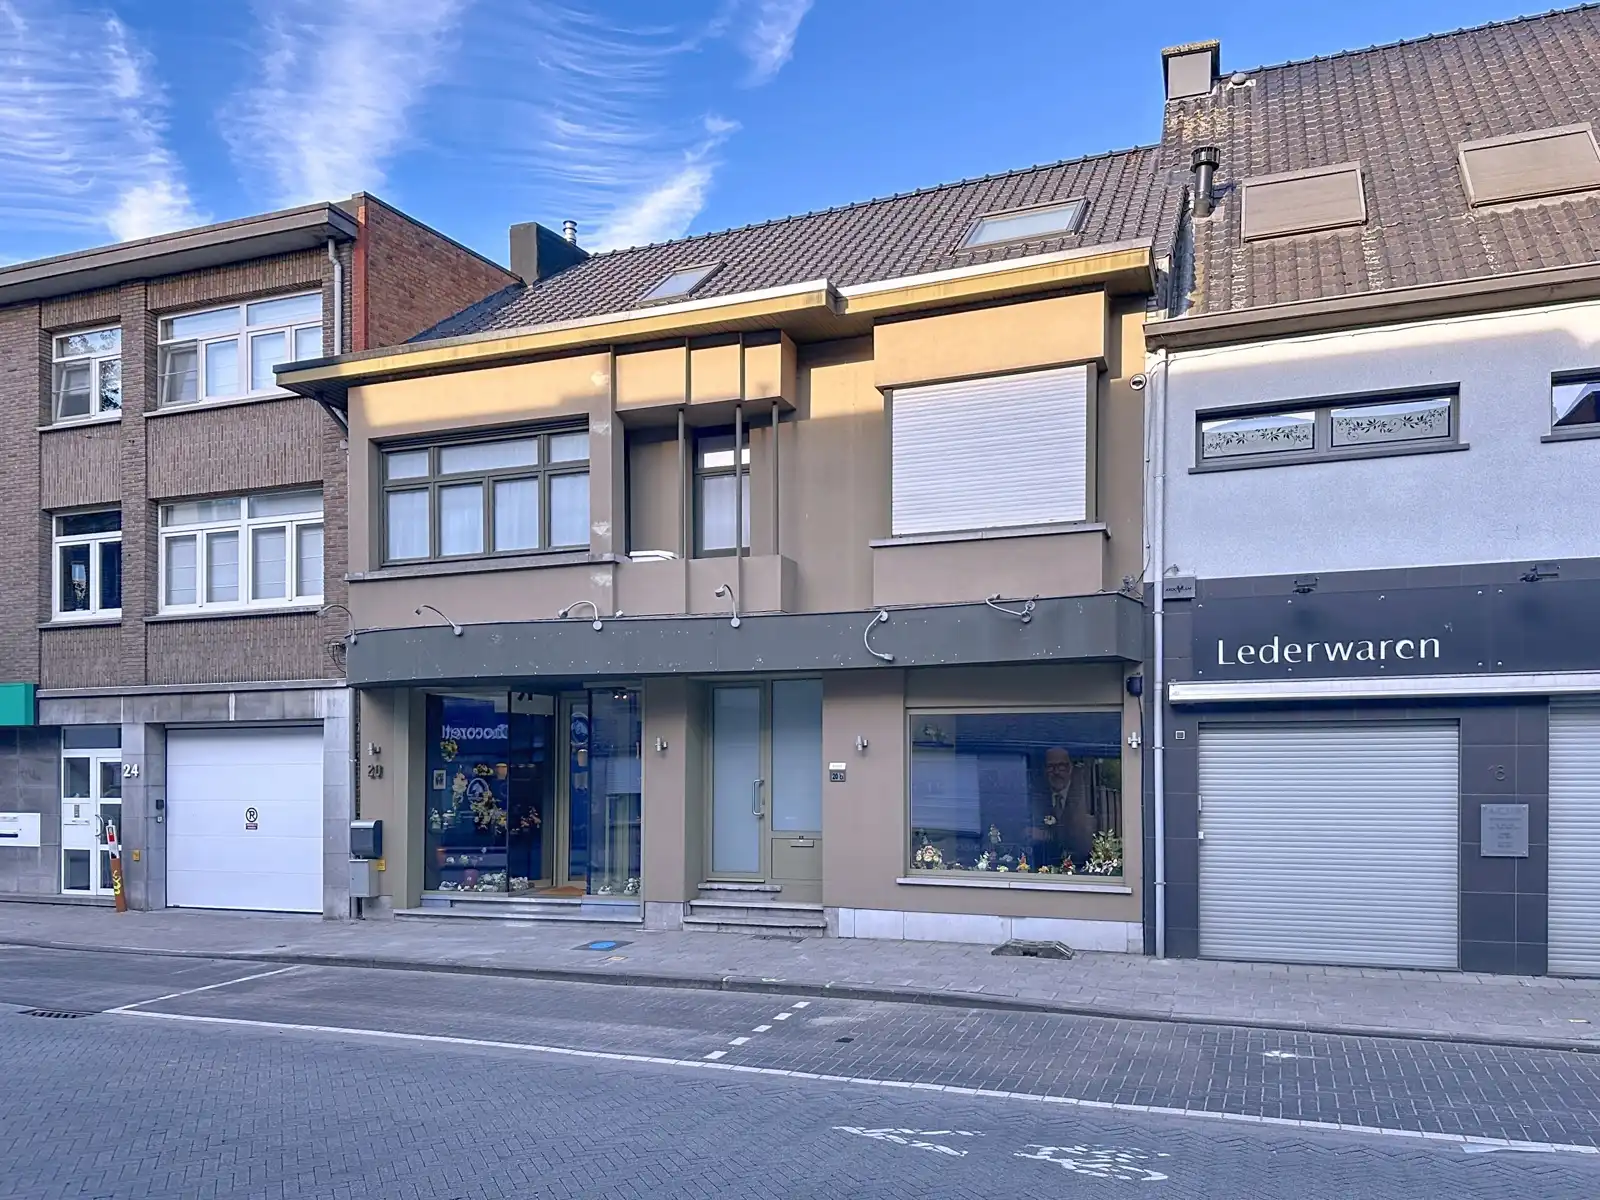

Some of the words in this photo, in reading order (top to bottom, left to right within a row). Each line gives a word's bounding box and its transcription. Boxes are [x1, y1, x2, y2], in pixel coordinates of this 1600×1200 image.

[1217, 635, 1441, 666] Lederwaren
[123, 763, 140, 778] 24
[367, 764, 384, 780] 20
[831, 772, 839, 780] 20
